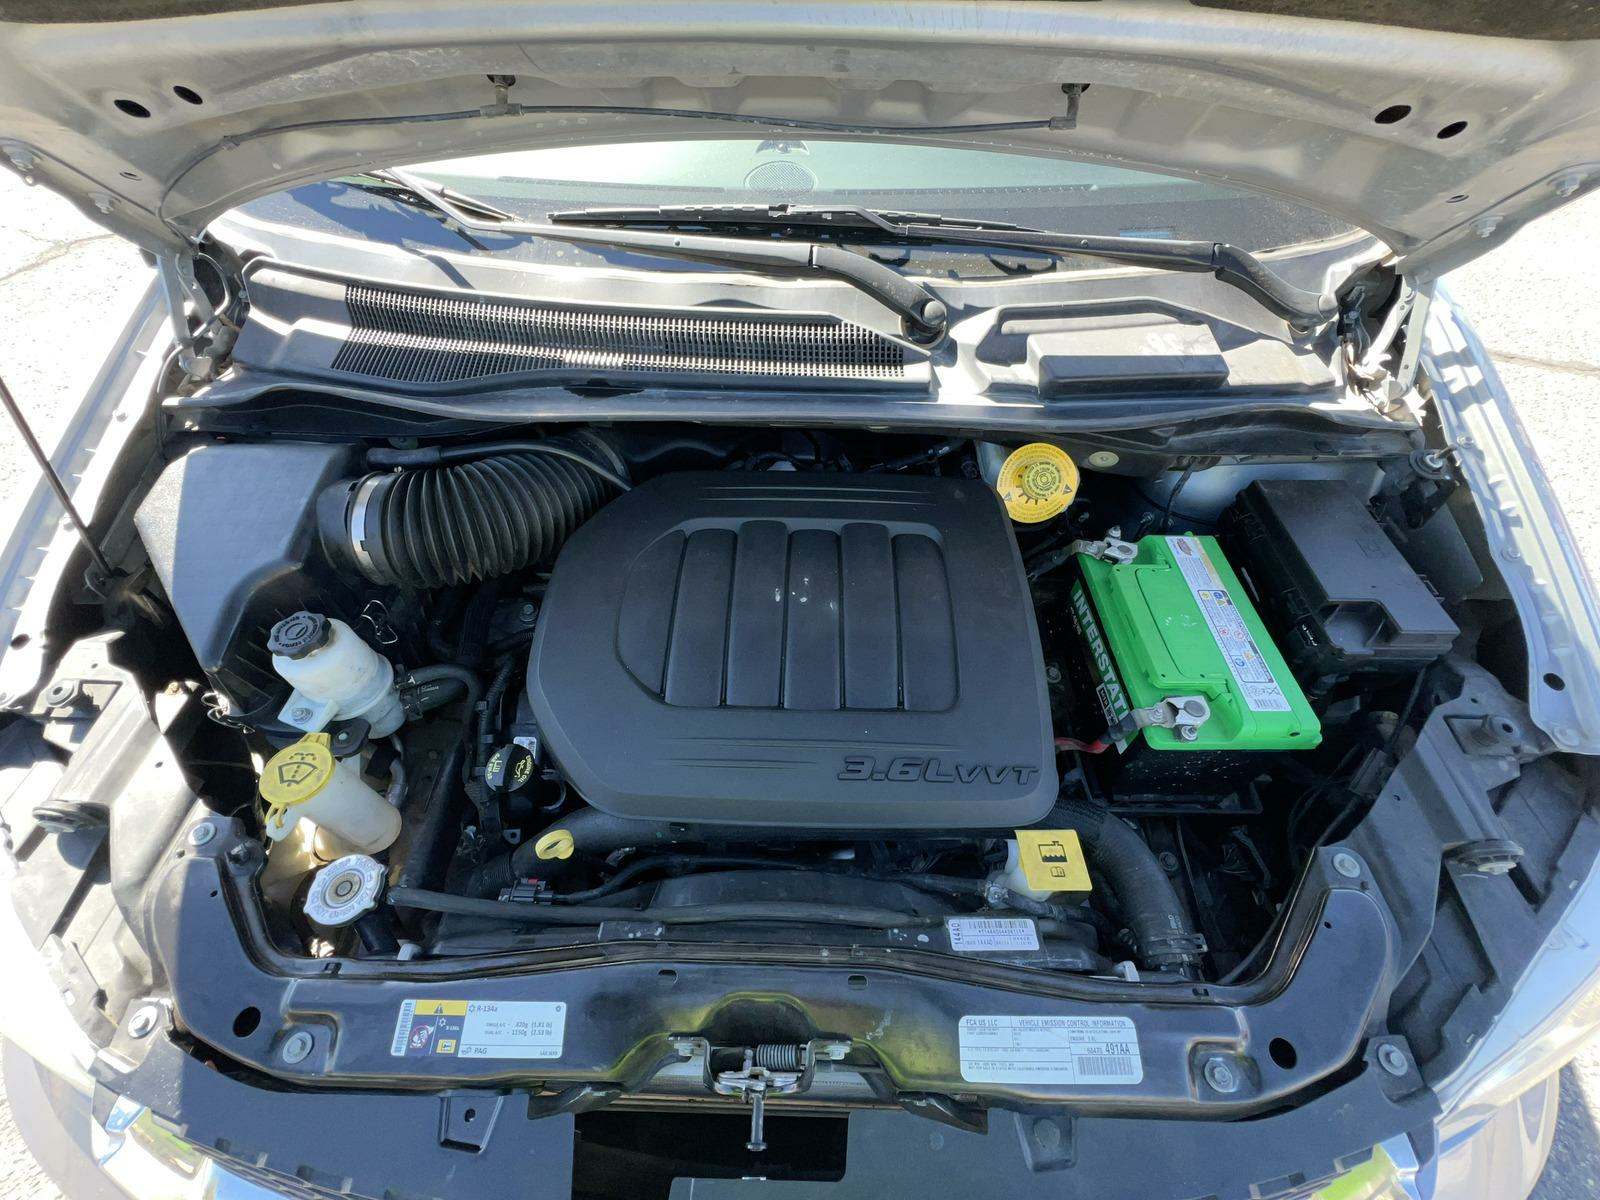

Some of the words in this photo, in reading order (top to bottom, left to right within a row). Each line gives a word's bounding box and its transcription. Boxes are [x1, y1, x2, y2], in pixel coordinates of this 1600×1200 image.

[1072, 590, 1132, 721] INTERSTAT
[837, 755, 956, 783] 3.6L
[955, 763, 1040, 786] VVT
[517, 775, 527, 783] OIL
[477, 1005, 498, 1013] R-134a
[1019, 1019, 1039, 1027] VEHICLE
[1041, 1019, 1065, 1027] EMISSION
[1067, 1019, 1089, 1028] CONTROL
[1092, 1019, 1126, 1027] INFORMATION
[473, 1047, 488, 1055] PAG
[1105, 1042, 1131, 1055] 491AA
